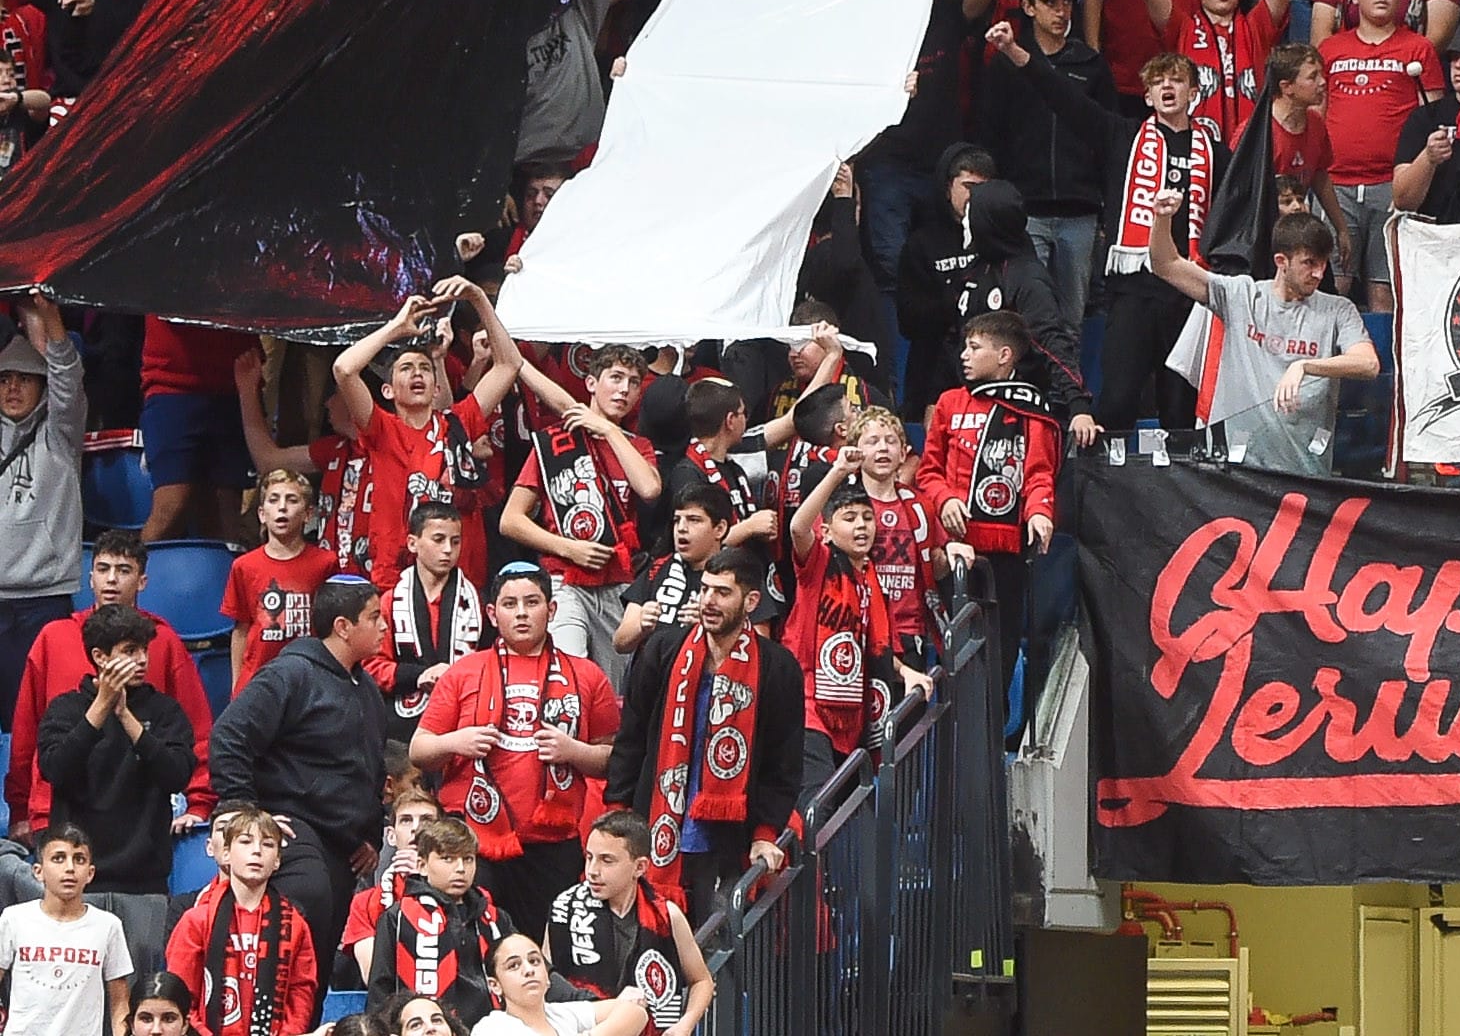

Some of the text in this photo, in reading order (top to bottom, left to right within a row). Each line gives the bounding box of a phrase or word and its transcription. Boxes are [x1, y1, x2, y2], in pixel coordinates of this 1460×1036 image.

[1329, 60, 1404, 74] JERUSALEM
[262, 629, 284, 641] 2023
[19, 946, 102, 967] HAPOEL
